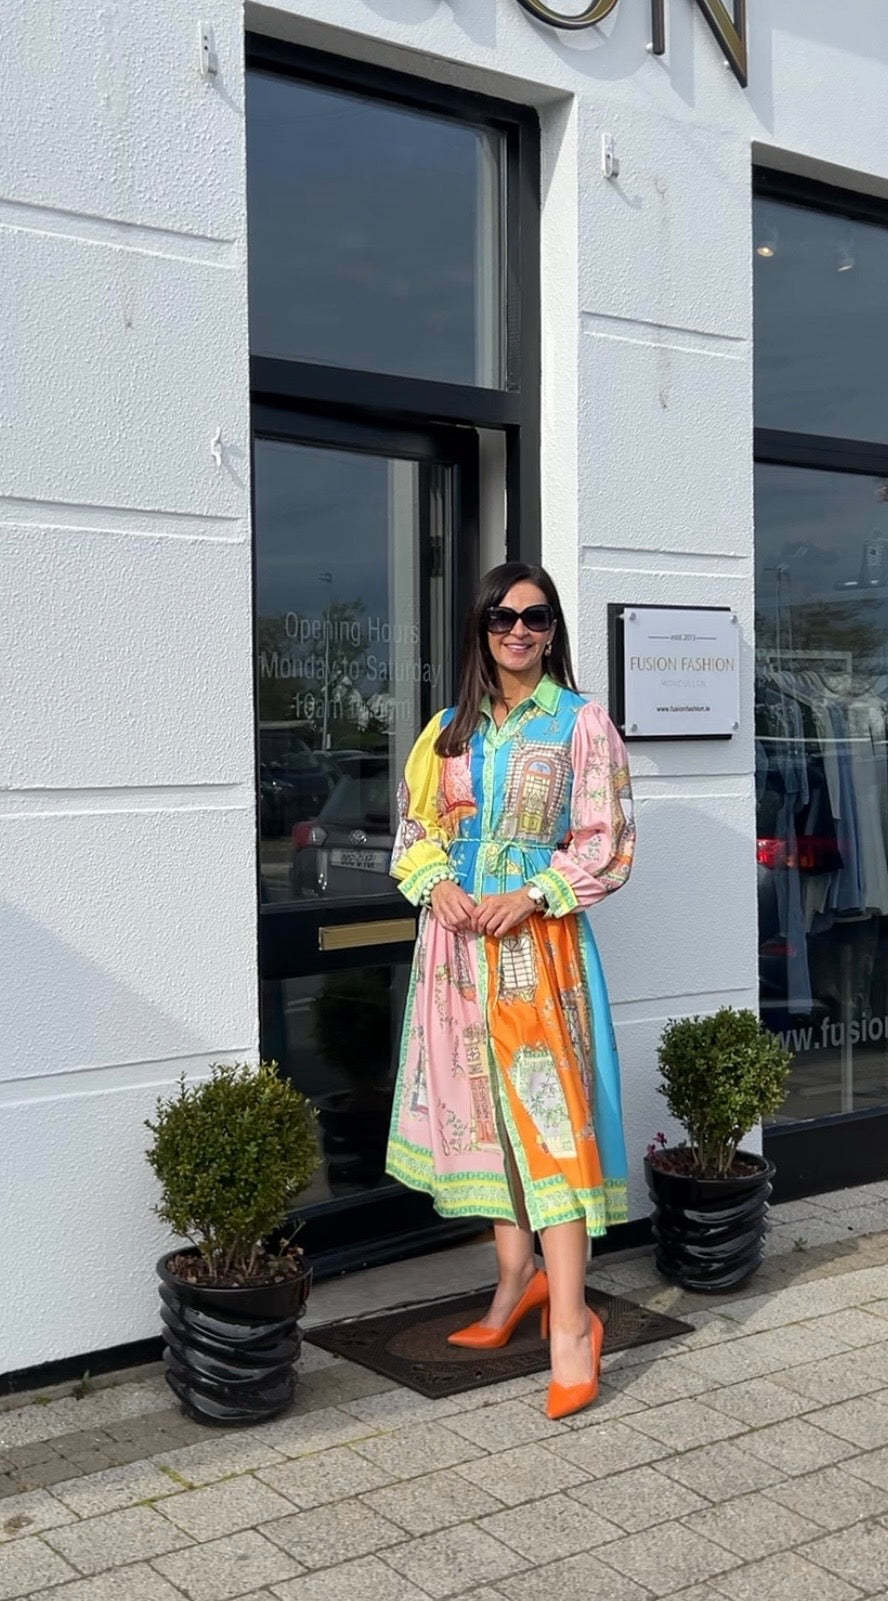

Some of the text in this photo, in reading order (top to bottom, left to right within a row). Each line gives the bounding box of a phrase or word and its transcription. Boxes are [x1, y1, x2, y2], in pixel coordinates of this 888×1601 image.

[285, 611, 420, 647] Opening Hours
[260, 651, 442, 688] Monday to Saturday
[629, 656, 736, 672] FUSION FASHION
